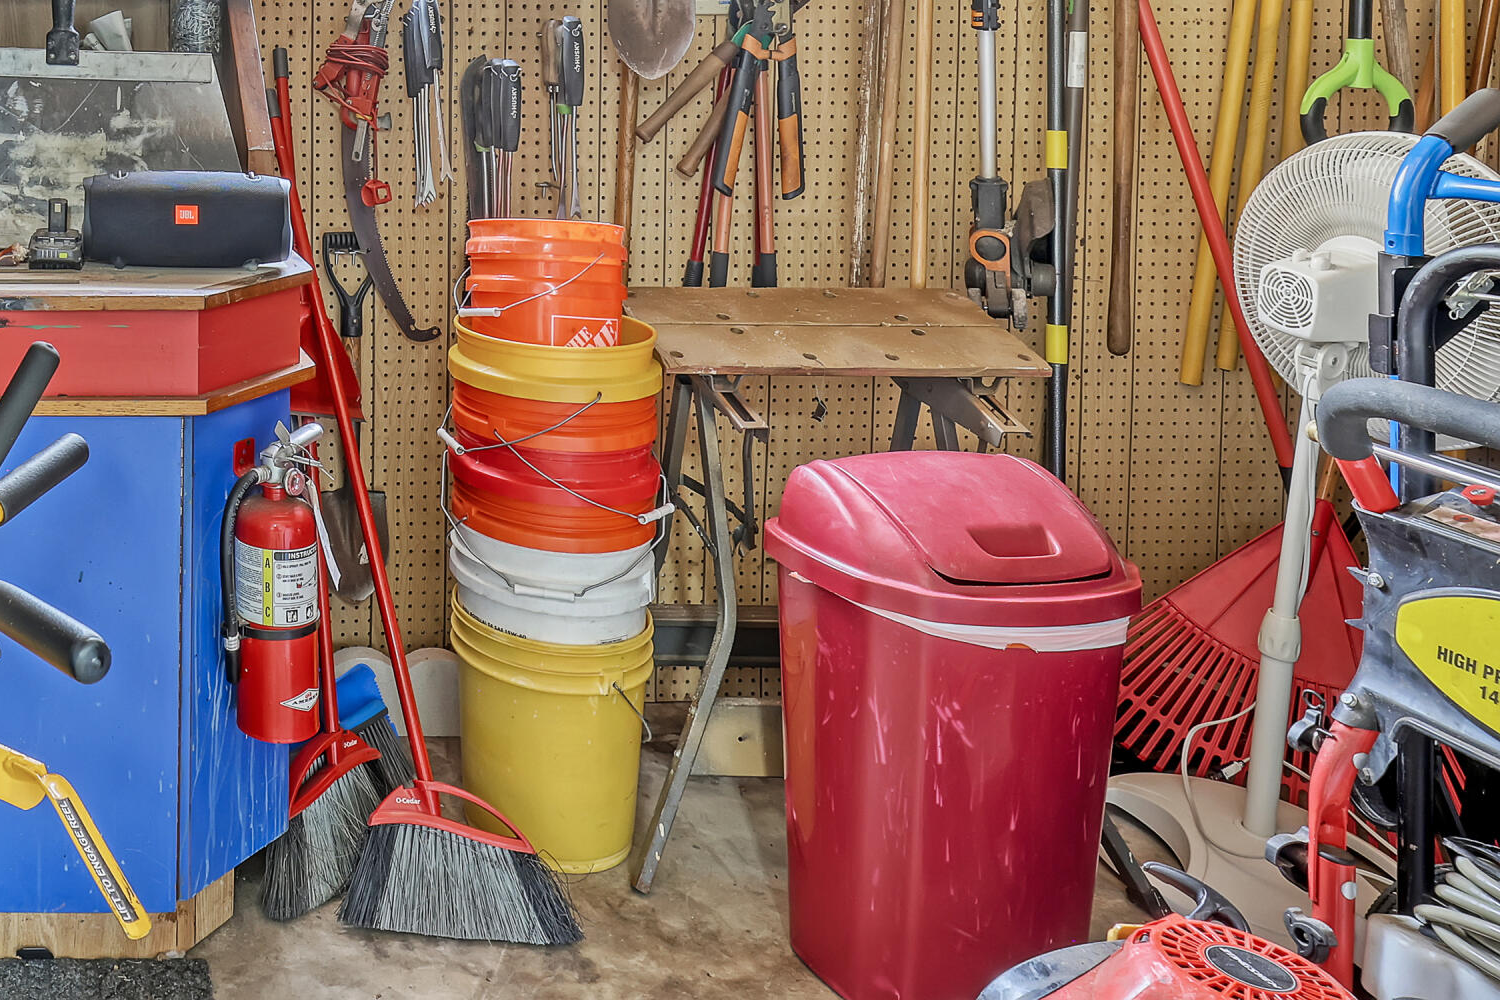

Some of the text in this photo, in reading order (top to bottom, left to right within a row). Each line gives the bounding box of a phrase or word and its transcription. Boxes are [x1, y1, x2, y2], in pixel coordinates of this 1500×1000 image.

[180, 209, 195, 220] JBL
[264, 557, 270, 569] A
[264, 581, 270, 593] B
[264, 606, 270, 618] C
[1437, 645, 1477, 675] HIGH
[1479, 685, 1499, 705] 14
[396, 797, 421, 805] O-Cedar
[59, 800, 132, 922] LIFT TO ENGAGE REEL
